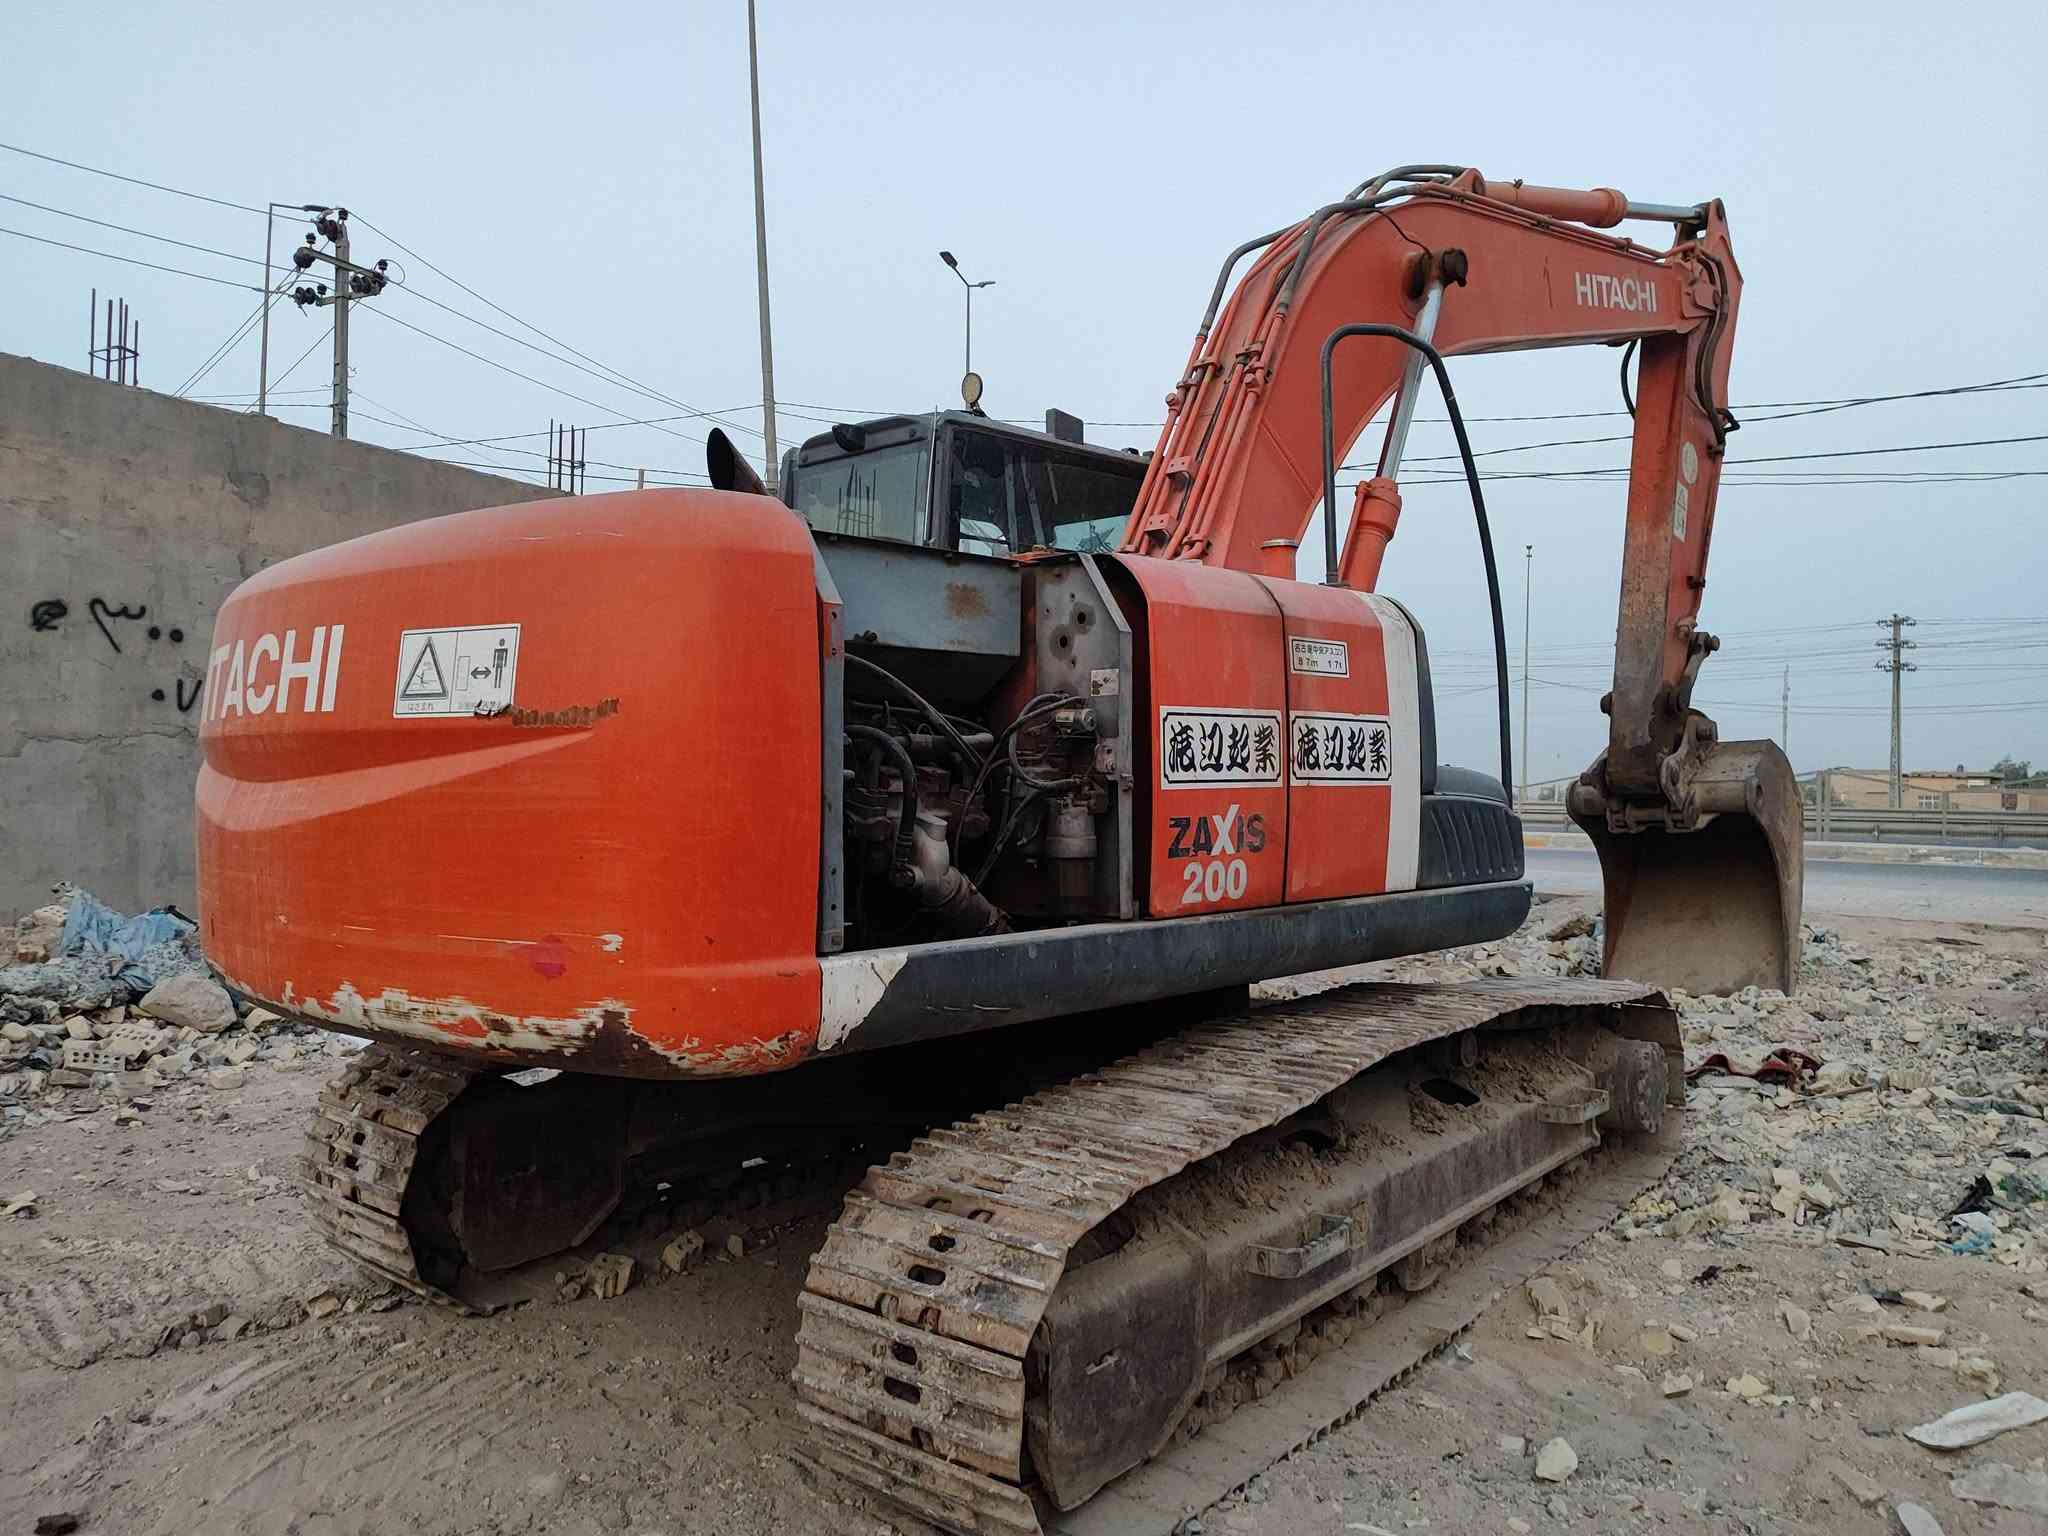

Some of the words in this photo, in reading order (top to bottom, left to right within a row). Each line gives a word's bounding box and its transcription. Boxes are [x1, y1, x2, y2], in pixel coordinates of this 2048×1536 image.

[1574, 271, 1657, 313] HITACHI
[201, 624, 345, 721] ITACHI
[1168, 804, 1265, 859] ZAXIS
[1182, 859, 1247, 904] 200
